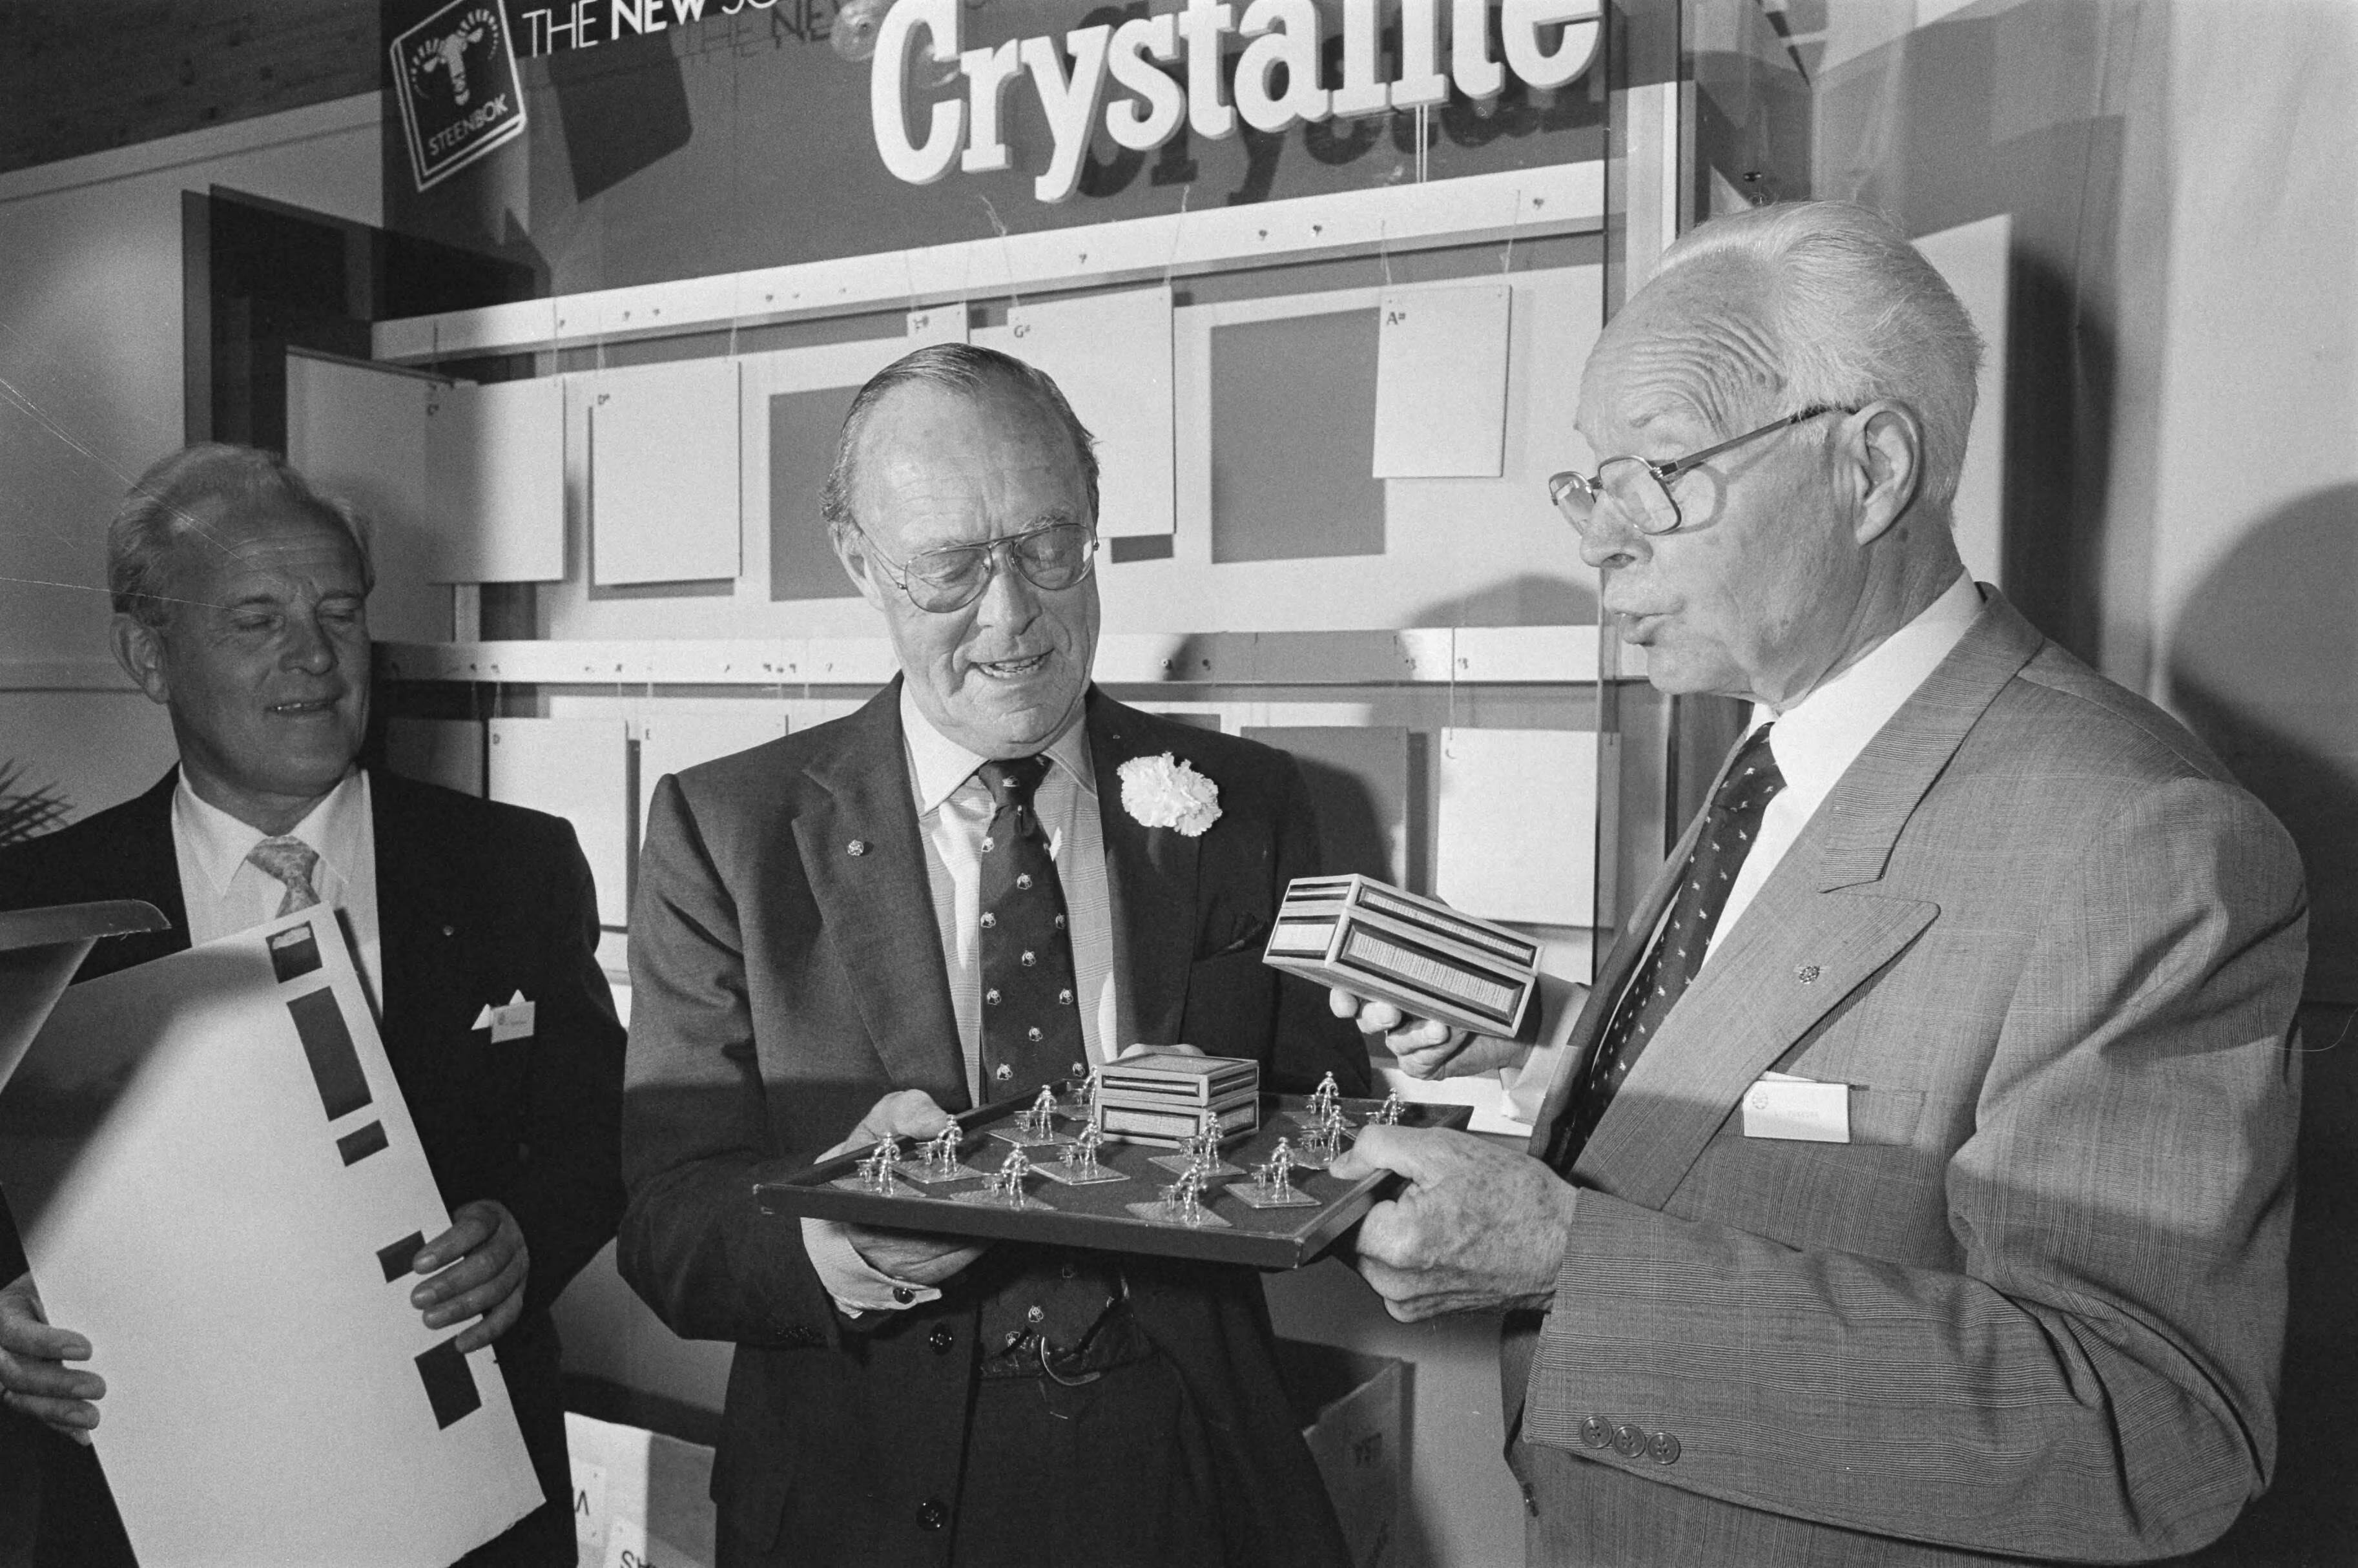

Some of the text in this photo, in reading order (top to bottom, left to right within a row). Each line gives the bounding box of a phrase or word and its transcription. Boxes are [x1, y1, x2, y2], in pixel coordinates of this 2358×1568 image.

[522, 0, 706, 57] THE NEW
[428, 93, 508, 156] STEENBOK
